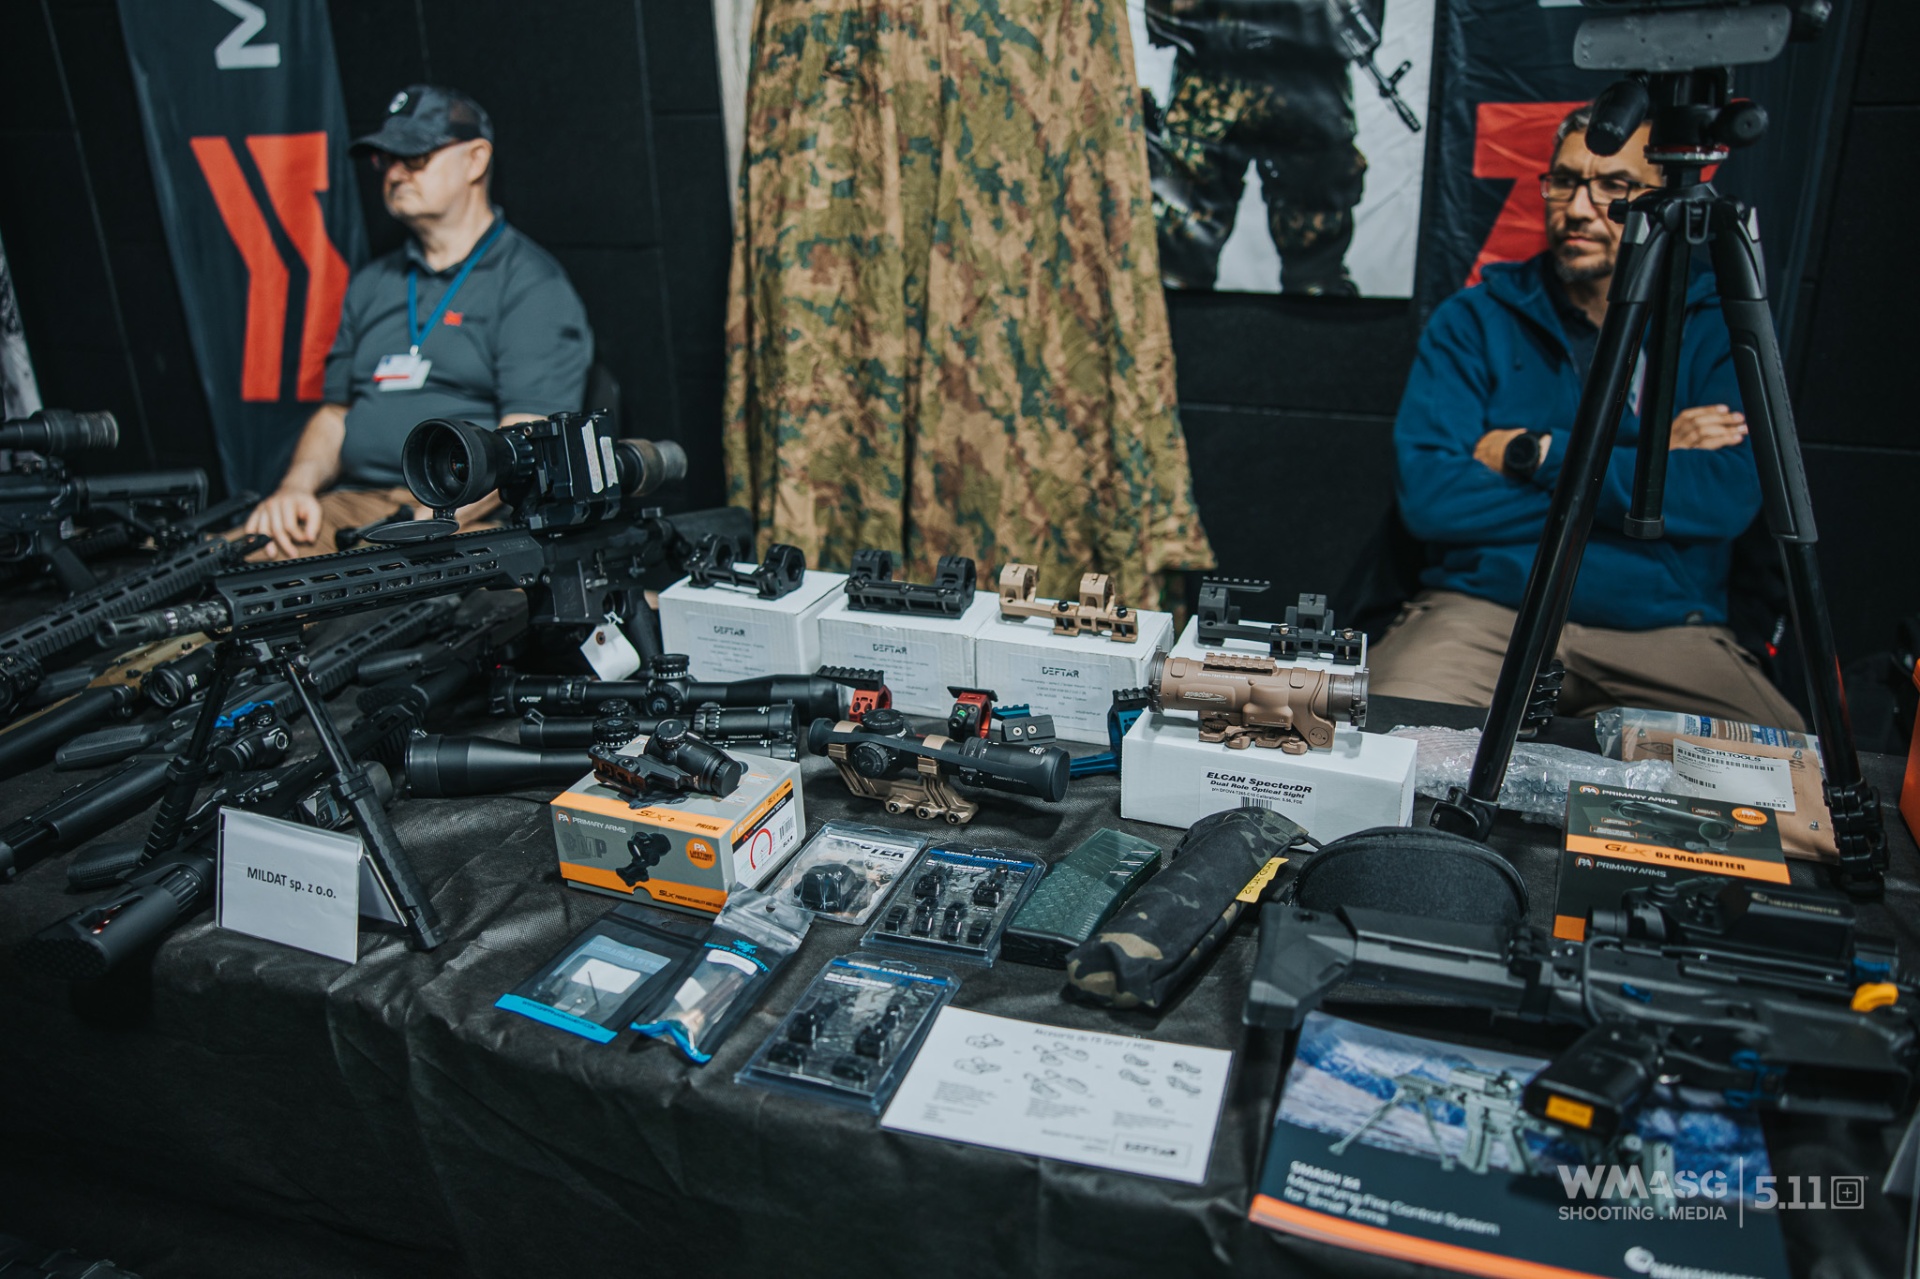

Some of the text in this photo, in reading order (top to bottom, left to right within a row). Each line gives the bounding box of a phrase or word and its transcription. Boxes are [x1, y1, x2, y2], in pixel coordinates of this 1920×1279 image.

[872, 643, 908, 655] DEFTAR
[1041, 666, 1080, 678] DEFTAR
[1206, 771, 1313, 793] ELCAN SpecterDR
[1230, 783, 1249, 791] Role
[1251, 786, 1282, 796] Optical
[1283, 791, 1306, 799] Sight
[1602, 789, 1646, 800] PRIMARY
[1648, 795, 1678, 805] ARMS
[558, 813, 627, 834] PA PRIMARY ARMS
[695, 823, 720, 831] PRISM
[694, 842, 707, 853] PA
[1577, 858, 1667, 878] PA PRIMARY ARMS
[1673, 854, 1746, 871] MAGNIFIER
[247, 866, 337, 899] MILDAT sp. z o.o.
[881, 967, 934, 980] ARMAMENT
[1305, 1193, 1347, 1215] Small
[1347, 1203, 1390, 1227] Arms
[1362, 1193, 1391, 1212] Fire
[1390, 1200, 1444, 1224] Control
[1443, 1211, 1501, 1237] System
